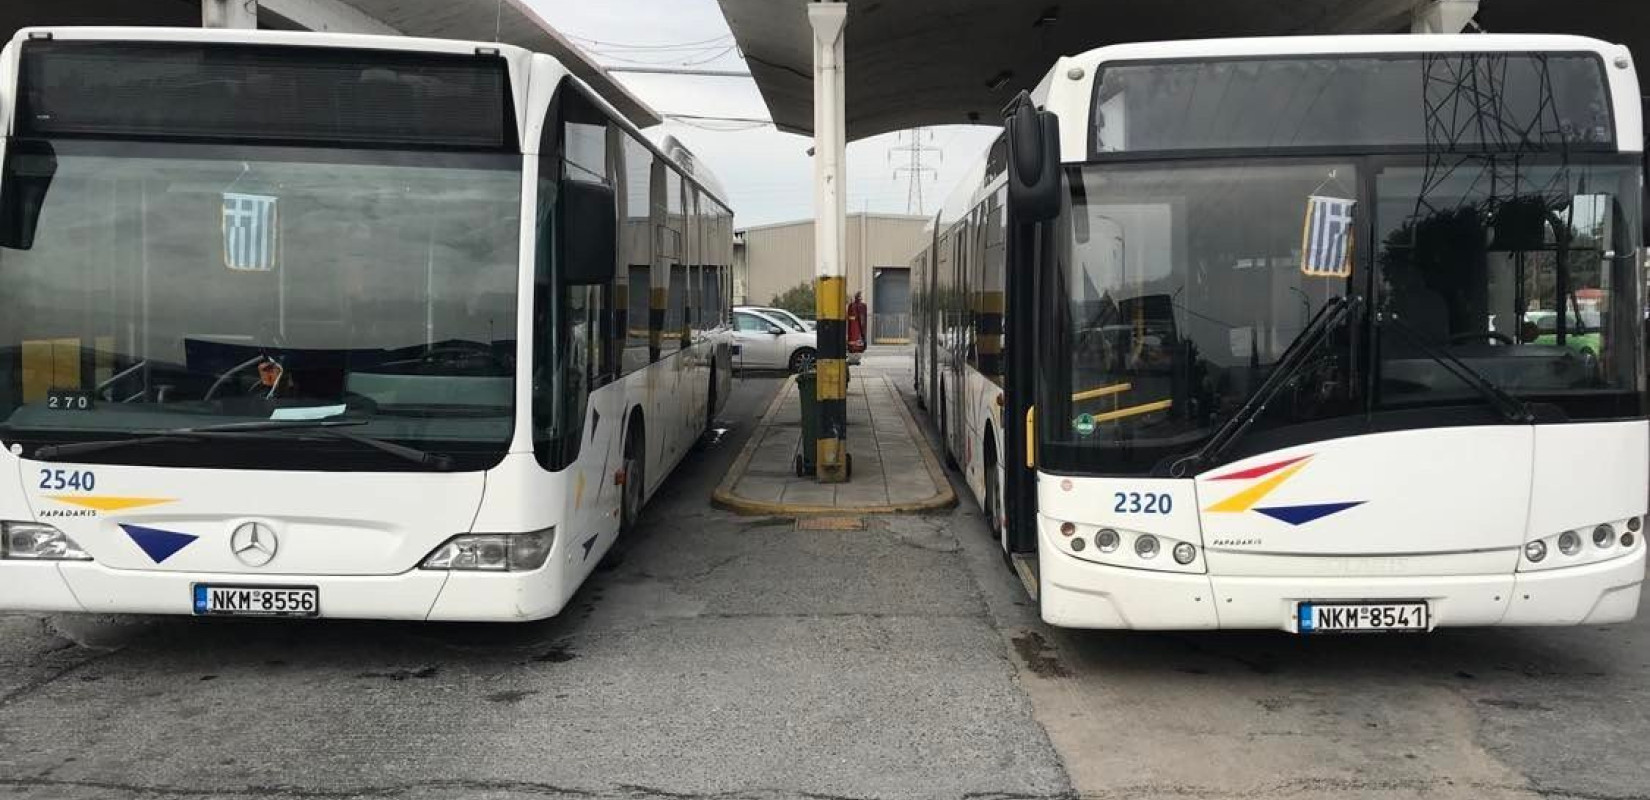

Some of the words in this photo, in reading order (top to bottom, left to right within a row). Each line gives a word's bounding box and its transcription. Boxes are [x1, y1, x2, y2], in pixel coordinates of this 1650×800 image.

[49, 396, 88, 409] 270
[38, 468, 96, 492] 2540
[1113, 491, 1173, 515] 2320
[212, 590, 314, 611] NKM-8556
[1318, 606, 1423, 628] NKM-8541
